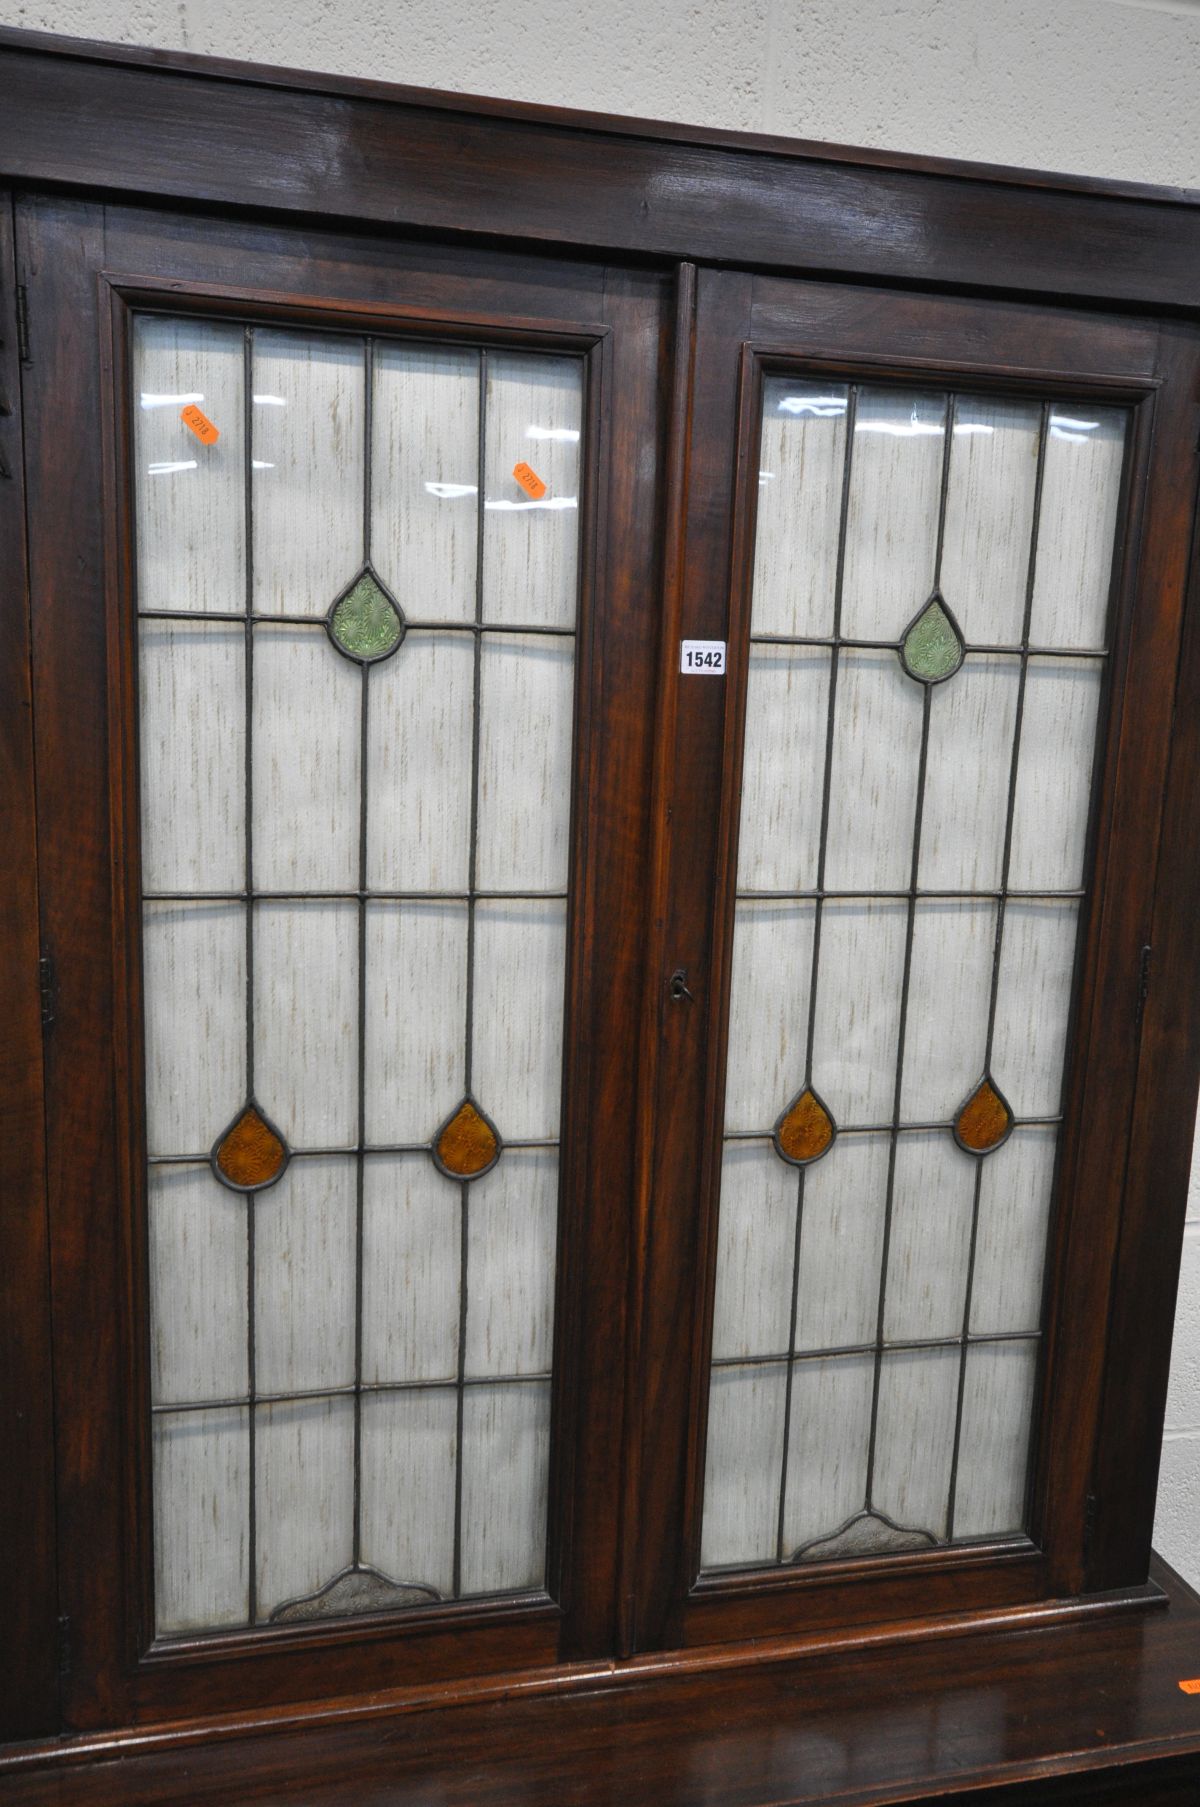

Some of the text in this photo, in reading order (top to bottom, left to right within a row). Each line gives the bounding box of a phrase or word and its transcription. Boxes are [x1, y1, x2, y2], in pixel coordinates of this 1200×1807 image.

[192, 417, 210, 435] 2718
[522, 473, 538, 490] 2718
[686, 651, 722, 668] 1542
